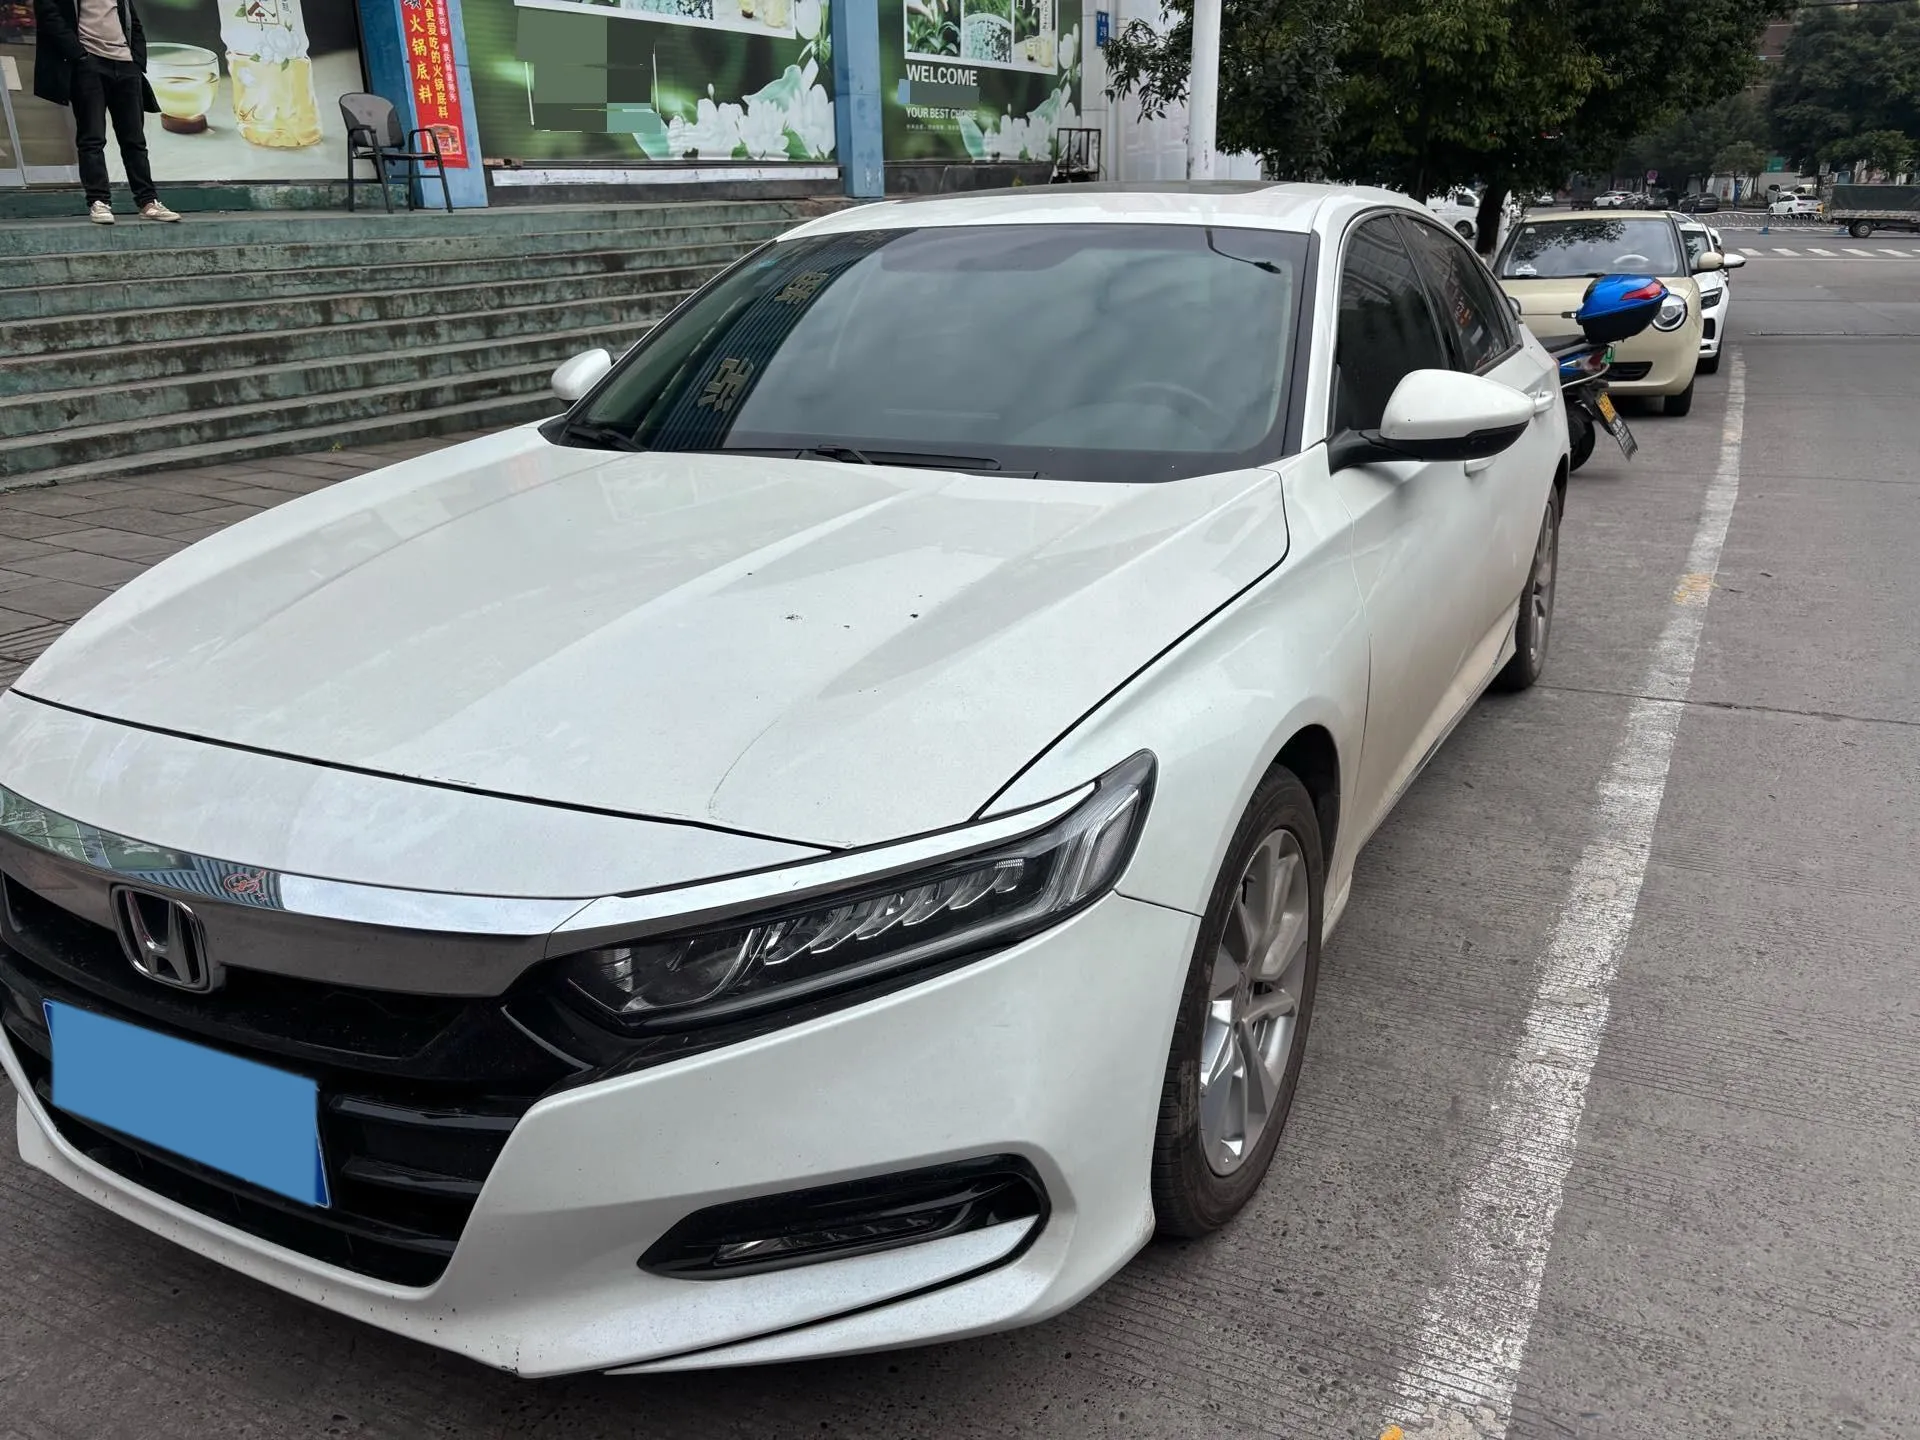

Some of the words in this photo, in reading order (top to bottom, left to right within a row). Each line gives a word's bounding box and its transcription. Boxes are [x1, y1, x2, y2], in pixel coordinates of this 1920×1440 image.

[410, 14, 432, 104] 火锅底料
[906, 64, 978, 86] WELCOME
[906, 107, 929, 118] YOUR
[930, 108, 949, 119] BEST
